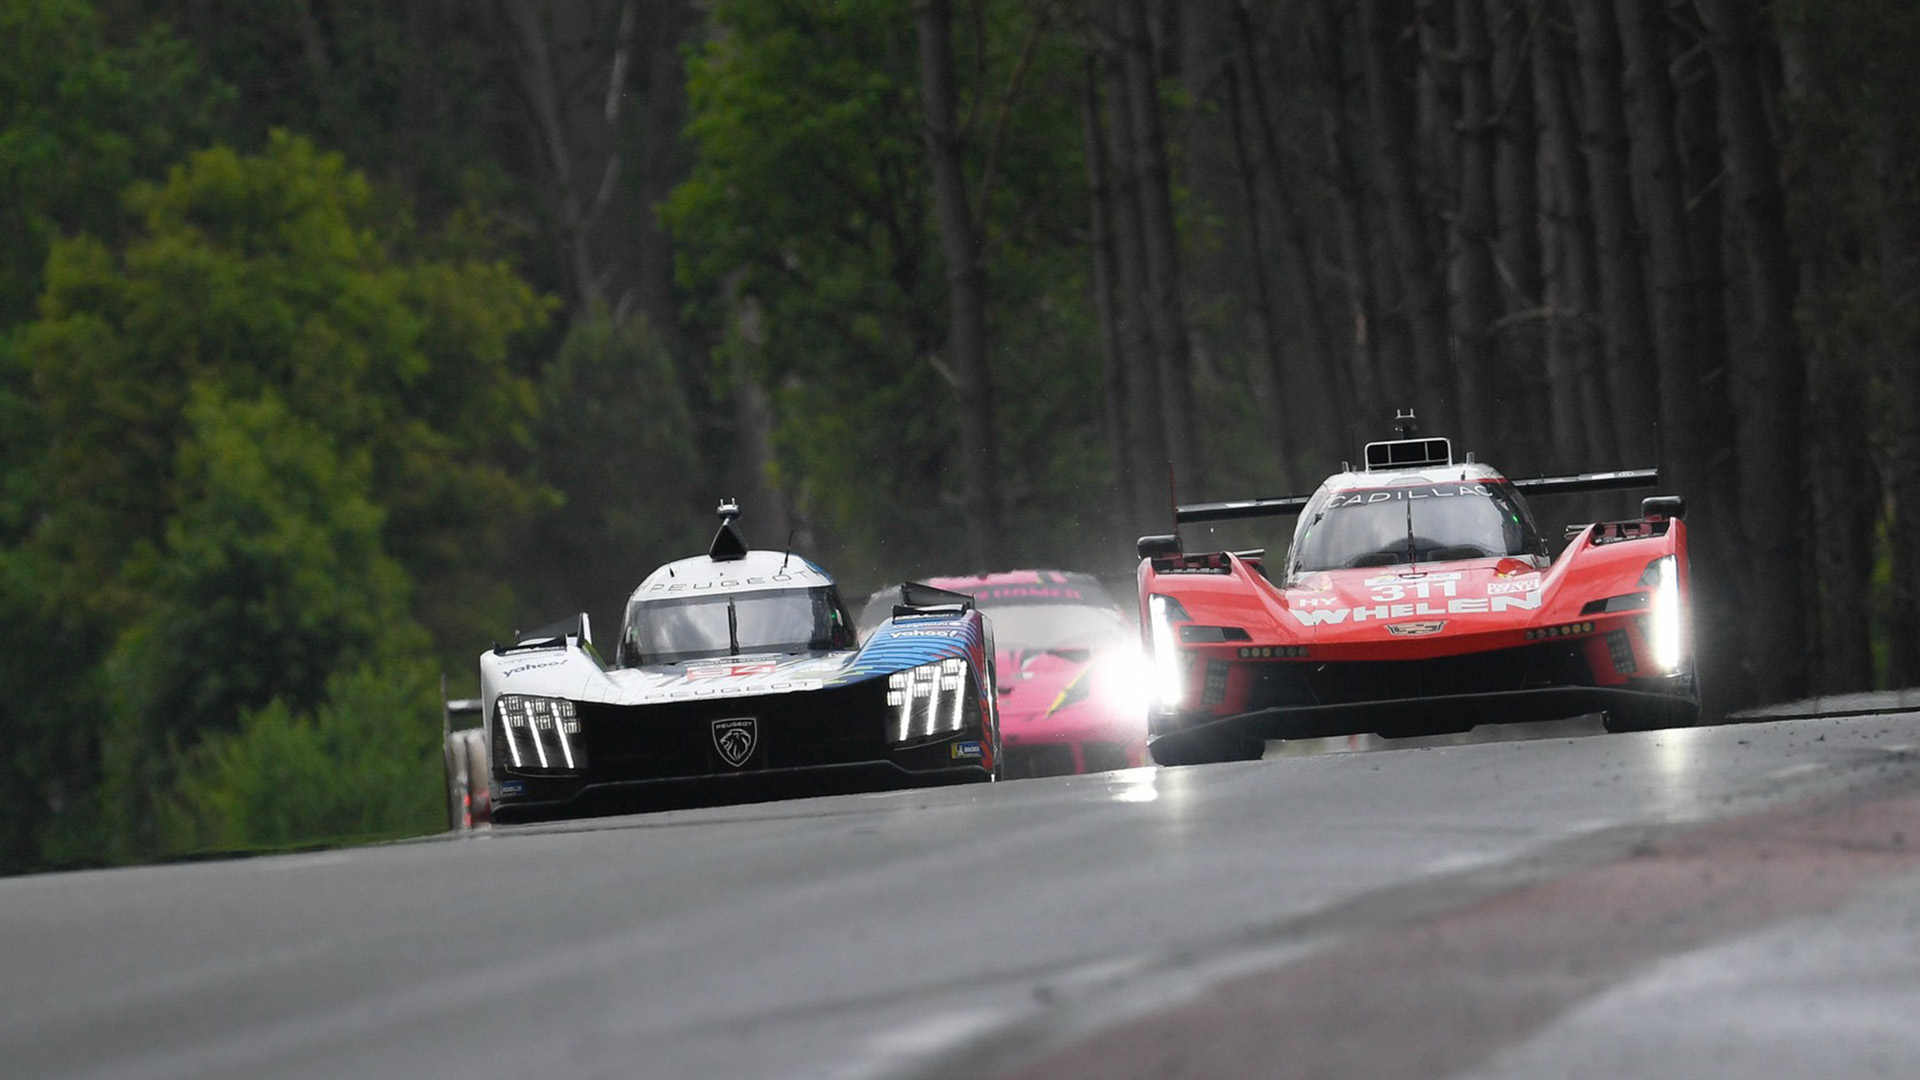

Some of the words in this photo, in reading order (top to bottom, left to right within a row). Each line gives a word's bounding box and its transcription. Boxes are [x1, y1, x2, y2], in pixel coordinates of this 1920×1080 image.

[1329, 485, 1493, 508] CADILLAC
[651, 571, 808, 592] PEUGEOT
[1371, 580, 1456, 602] 311
[1289, 595, 1542, 627] WHELEN
[1299, 597, 1338, 607] HY
[888, 629, 959, 639] yahoo!
[503, 659, 569, 678] yahoo!
[645, 681, 820, 699] PEUGEOT
[715, 721, 753, 729] PEUGEOT
